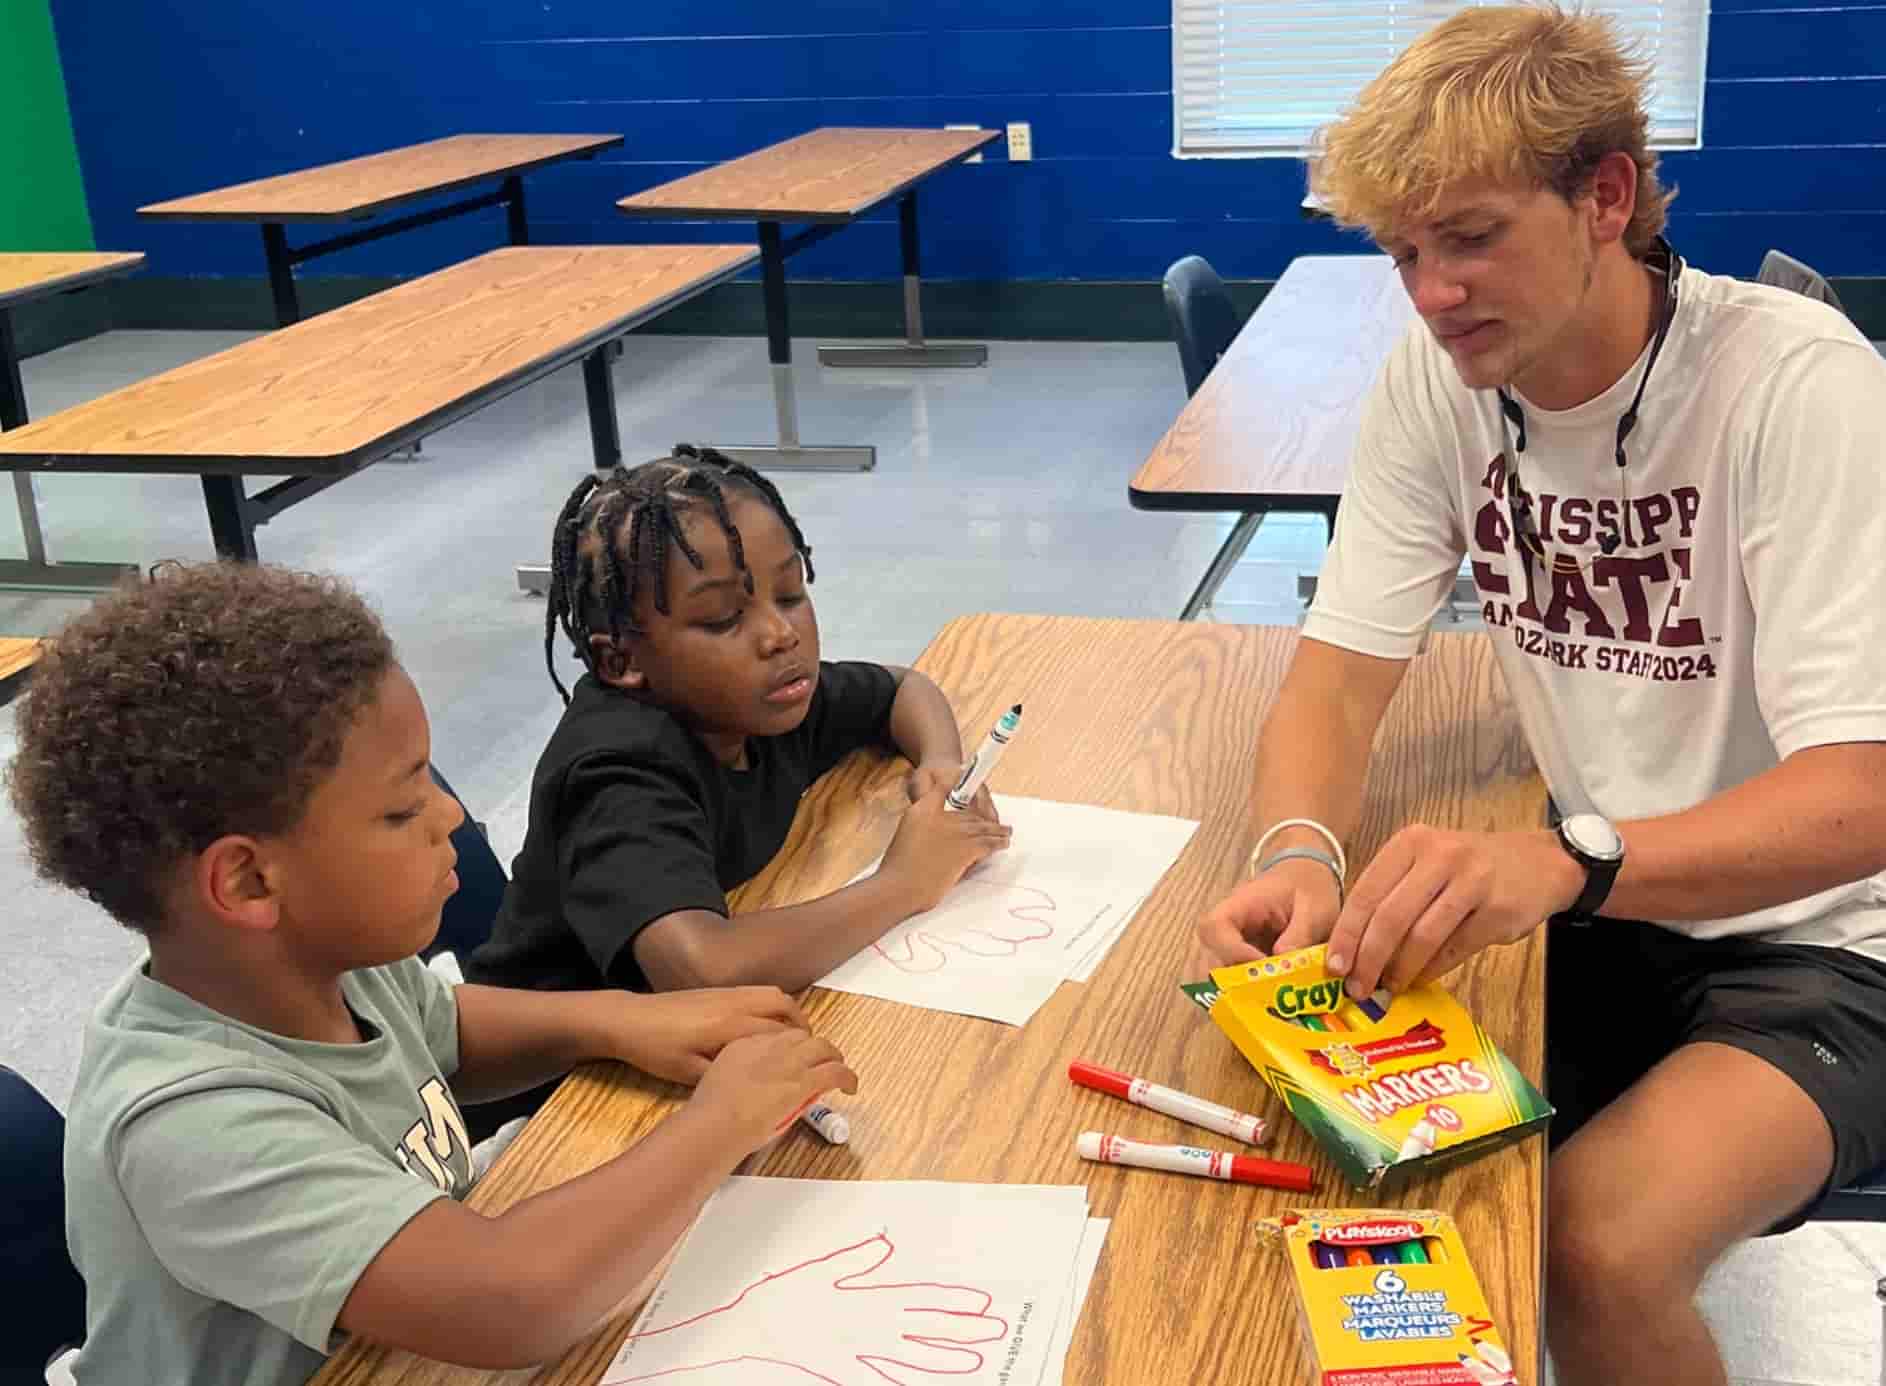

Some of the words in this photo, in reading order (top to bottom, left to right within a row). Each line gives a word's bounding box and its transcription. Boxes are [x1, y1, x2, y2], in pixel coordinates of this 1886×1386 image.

[1652, 653, 1717, 681] 2024
[1276, 979, 1341, 1015] Cray
[1342, 1059, 1491, 1122] MARKERS
[1428, 1106, 1459, 1130] 10
[1325, 1223, 1420, 1241] PLAYSKOOL
[1375, 1269, 1406, 1293] 6
[1342, 1291, 1447, 1305] WASHABLE
[1352, 1302, 1443, 1315] MARKERS
[1342, 1314, 1462, 1329] MARQUEURS
[1360, 1326, 1453, 1341] LAVABLES
